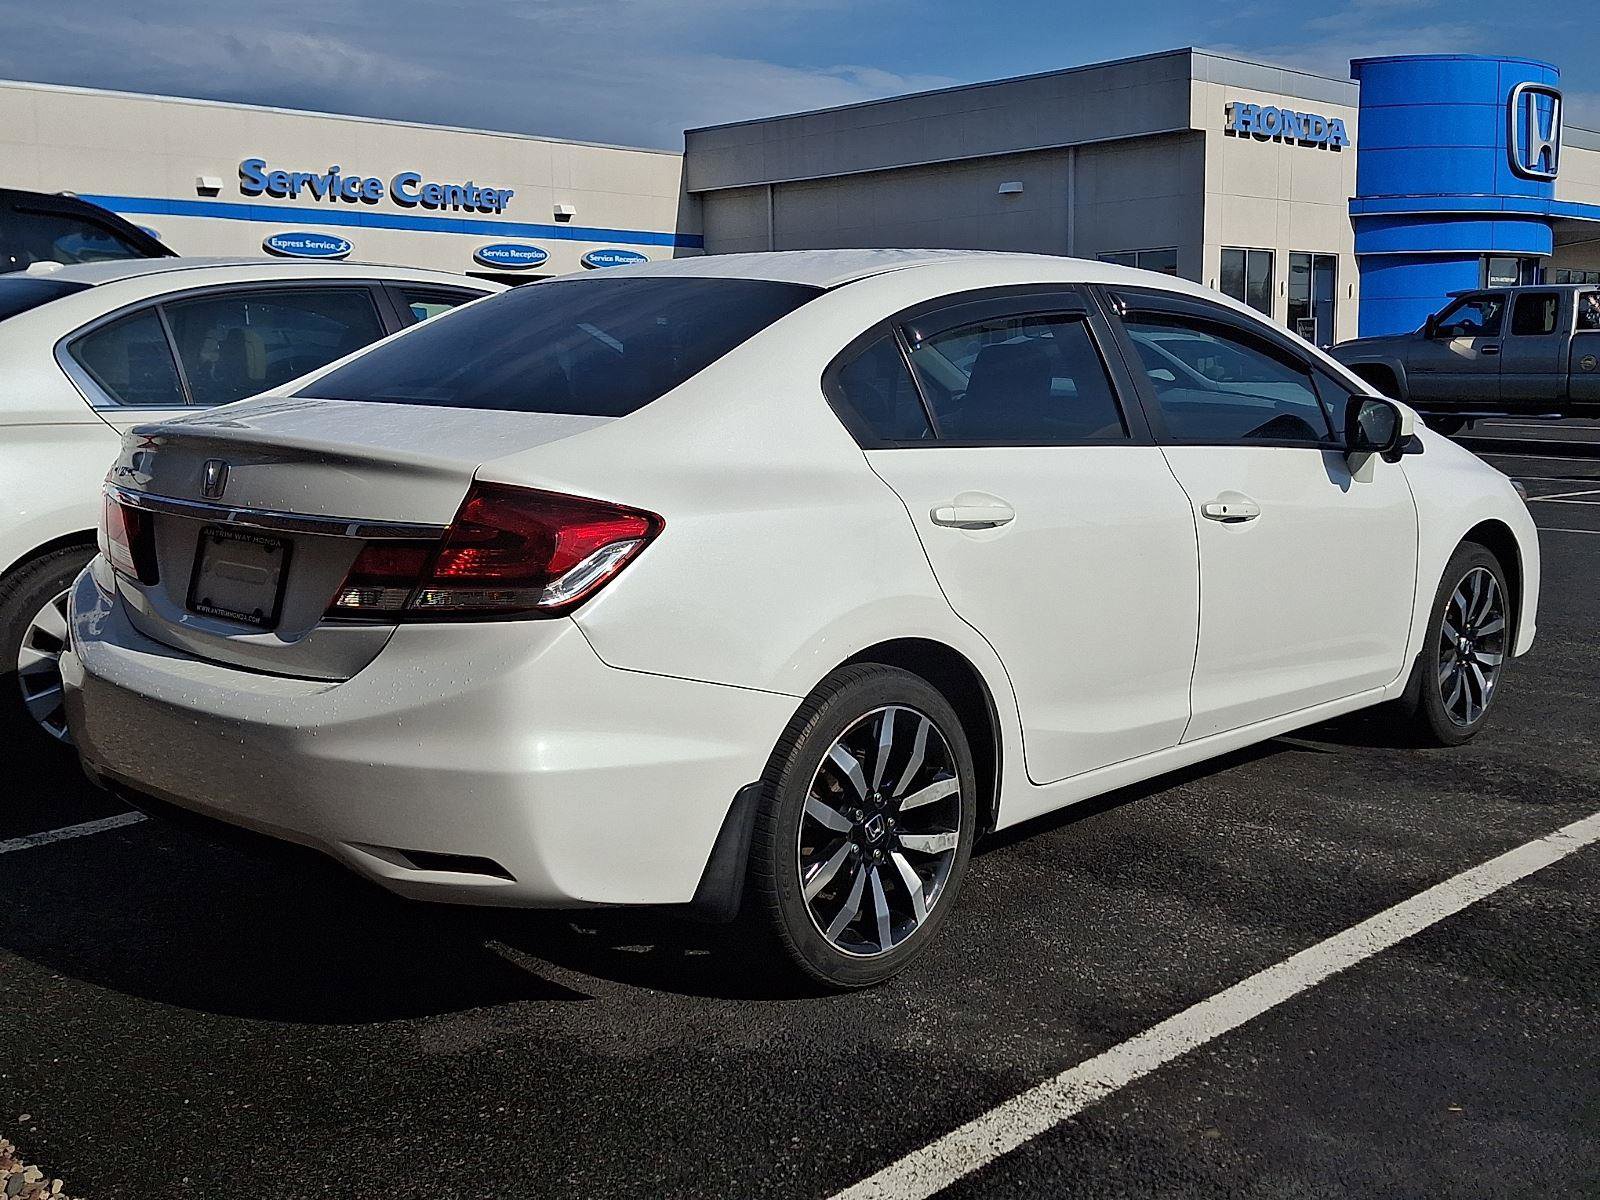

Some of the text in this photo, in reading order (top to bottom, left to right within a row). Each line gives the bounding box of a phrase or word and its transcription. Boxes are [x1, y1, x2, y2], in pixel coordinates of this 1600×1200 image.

[1227, 101, 1350, 148] HONDA
[239, 158, 514, 212] Service Center
[271, 238, 336, 250] Express Service
[482, 249, 546, 260] Service Reception
[589, 254, 646, 264] Service Reception
[234, 532, 252, 542] WAY
